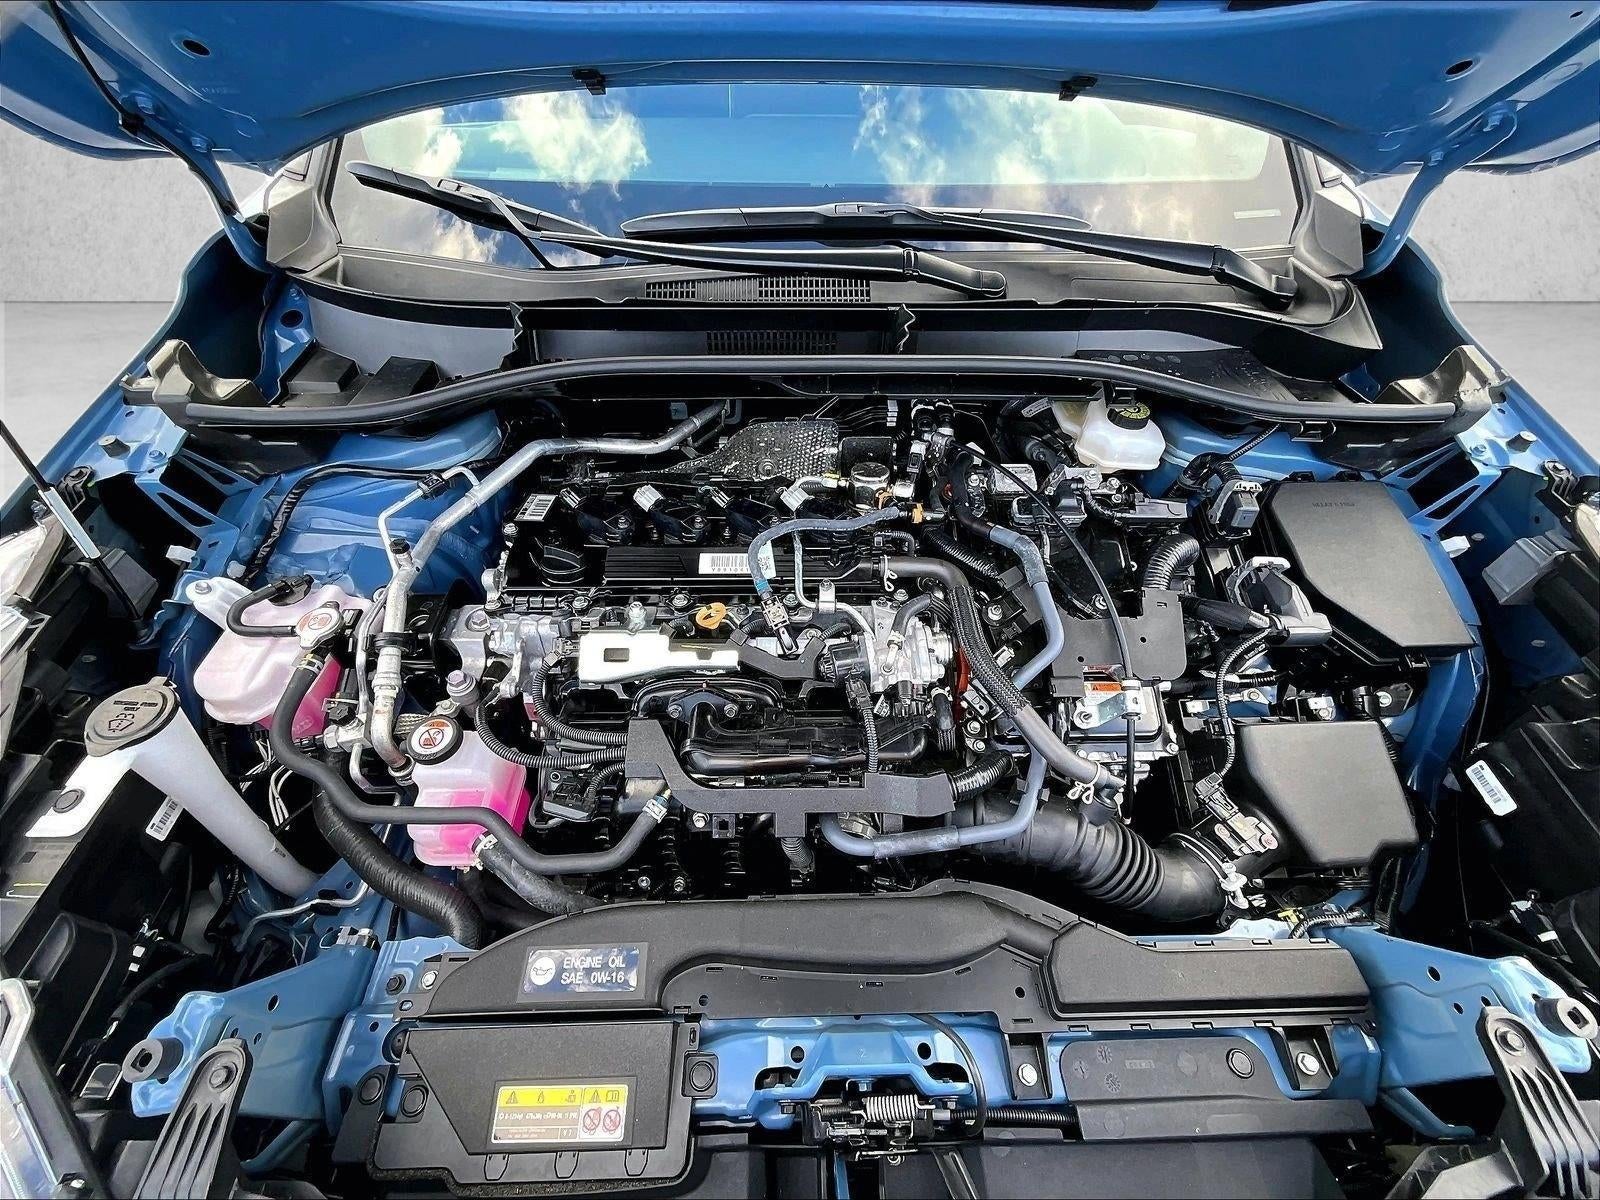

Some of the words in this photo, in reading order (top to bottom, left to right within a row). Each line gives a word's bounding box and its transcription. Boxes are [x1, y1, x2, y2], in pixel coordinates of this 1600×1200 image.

[563, 956, 602, 970] ENGINE
[608, 955, 626, 968] OIL
[560, 972, 583, 985] SAE
[590, 971, 625, 985] 0W-16
